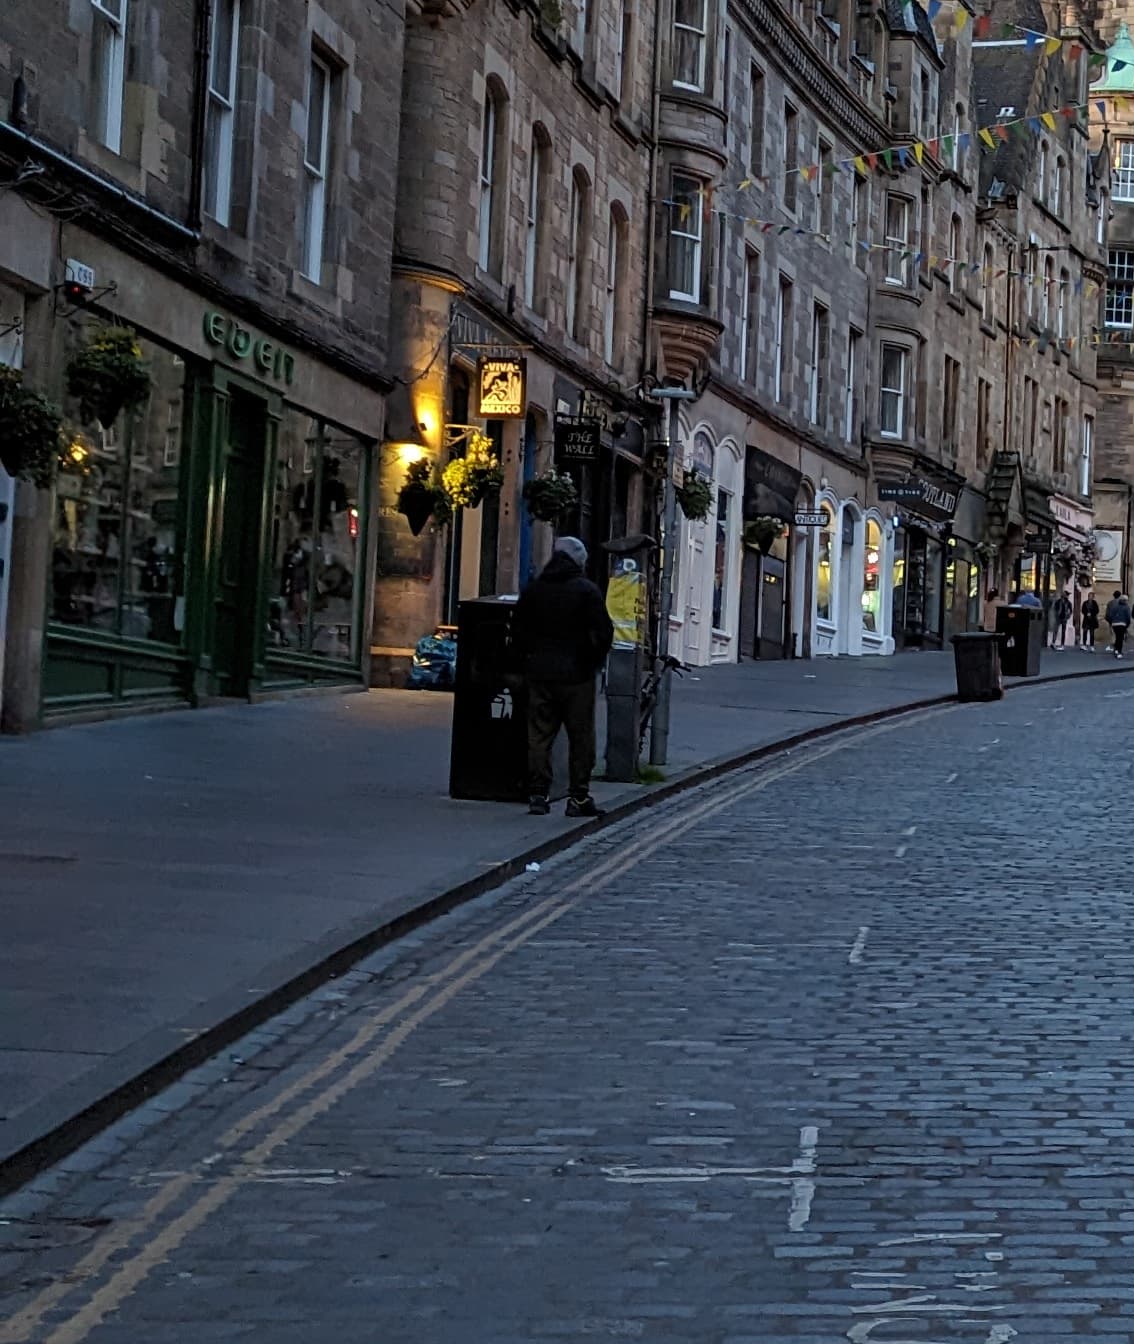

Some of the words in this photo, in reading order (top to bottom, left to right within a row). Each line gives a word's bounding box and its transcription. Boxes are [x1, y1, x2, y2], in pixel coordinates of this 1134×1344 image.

[488, 362, 515, 372] VIVA
[480, 404, 521, 414] MEXICO
[568, 430, 593, 443] THE
[565, 444, 595, 455] WALL
